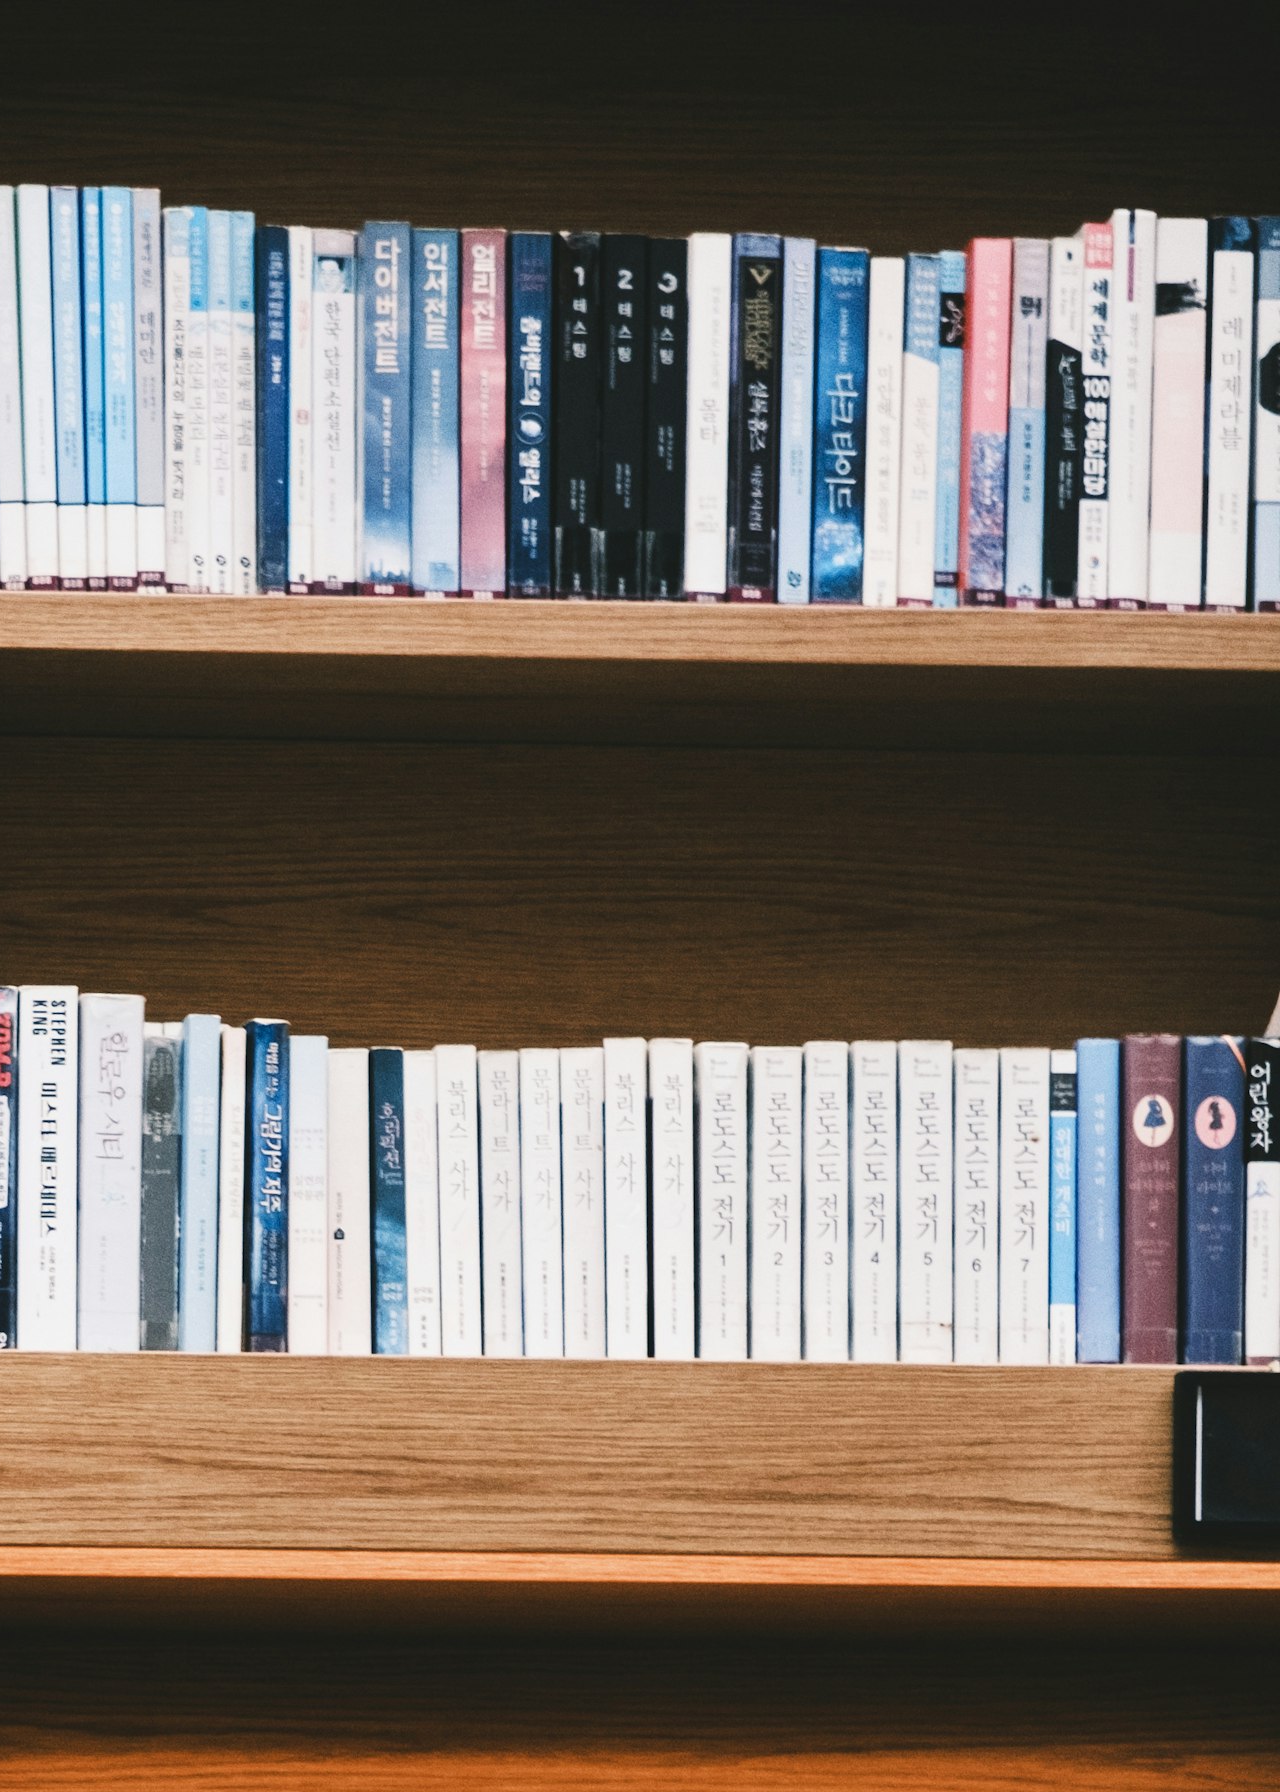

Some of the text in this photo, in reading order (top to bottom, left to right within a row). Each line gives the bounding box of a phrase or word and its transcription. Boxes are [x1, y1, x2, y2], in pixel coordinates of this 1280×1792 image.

[373, 237, 405, 374] 다이버전트
[423, 243, 450, 350] 인서전트
[471, 244, 497, 350] 얼리전트
[573, 265, 585, 287] 1
[617, 268, 633, 290] 2
[657, 272, 678, 294] 3
[32, 999, 48, 1036] KING
[50, 999, 67, 1066] STEPHEN
[39, 1082, 57, 1233] 미스터 메르세데스
[95, 1031, 129, 1161] 할로우 시티
[1248, 1061, 1274, 1154] 어린왕자
[712, 1092, 737, 1267] 로도스도 전기 1
[767, 1092, 792, 1267] 로도스도 전기 2
[816, 1091, 841, 1266] 로도스도 전기 3
[863, 1090, 888, 1265] 로도스도 전기 4
[916, 1091, 940, 1267] 로도스도 전기 5
[965, 1098, 989, 1273] 로도스도 전기 6
[1014, 1098, 1041, 1273] 로도스도 전기 7
